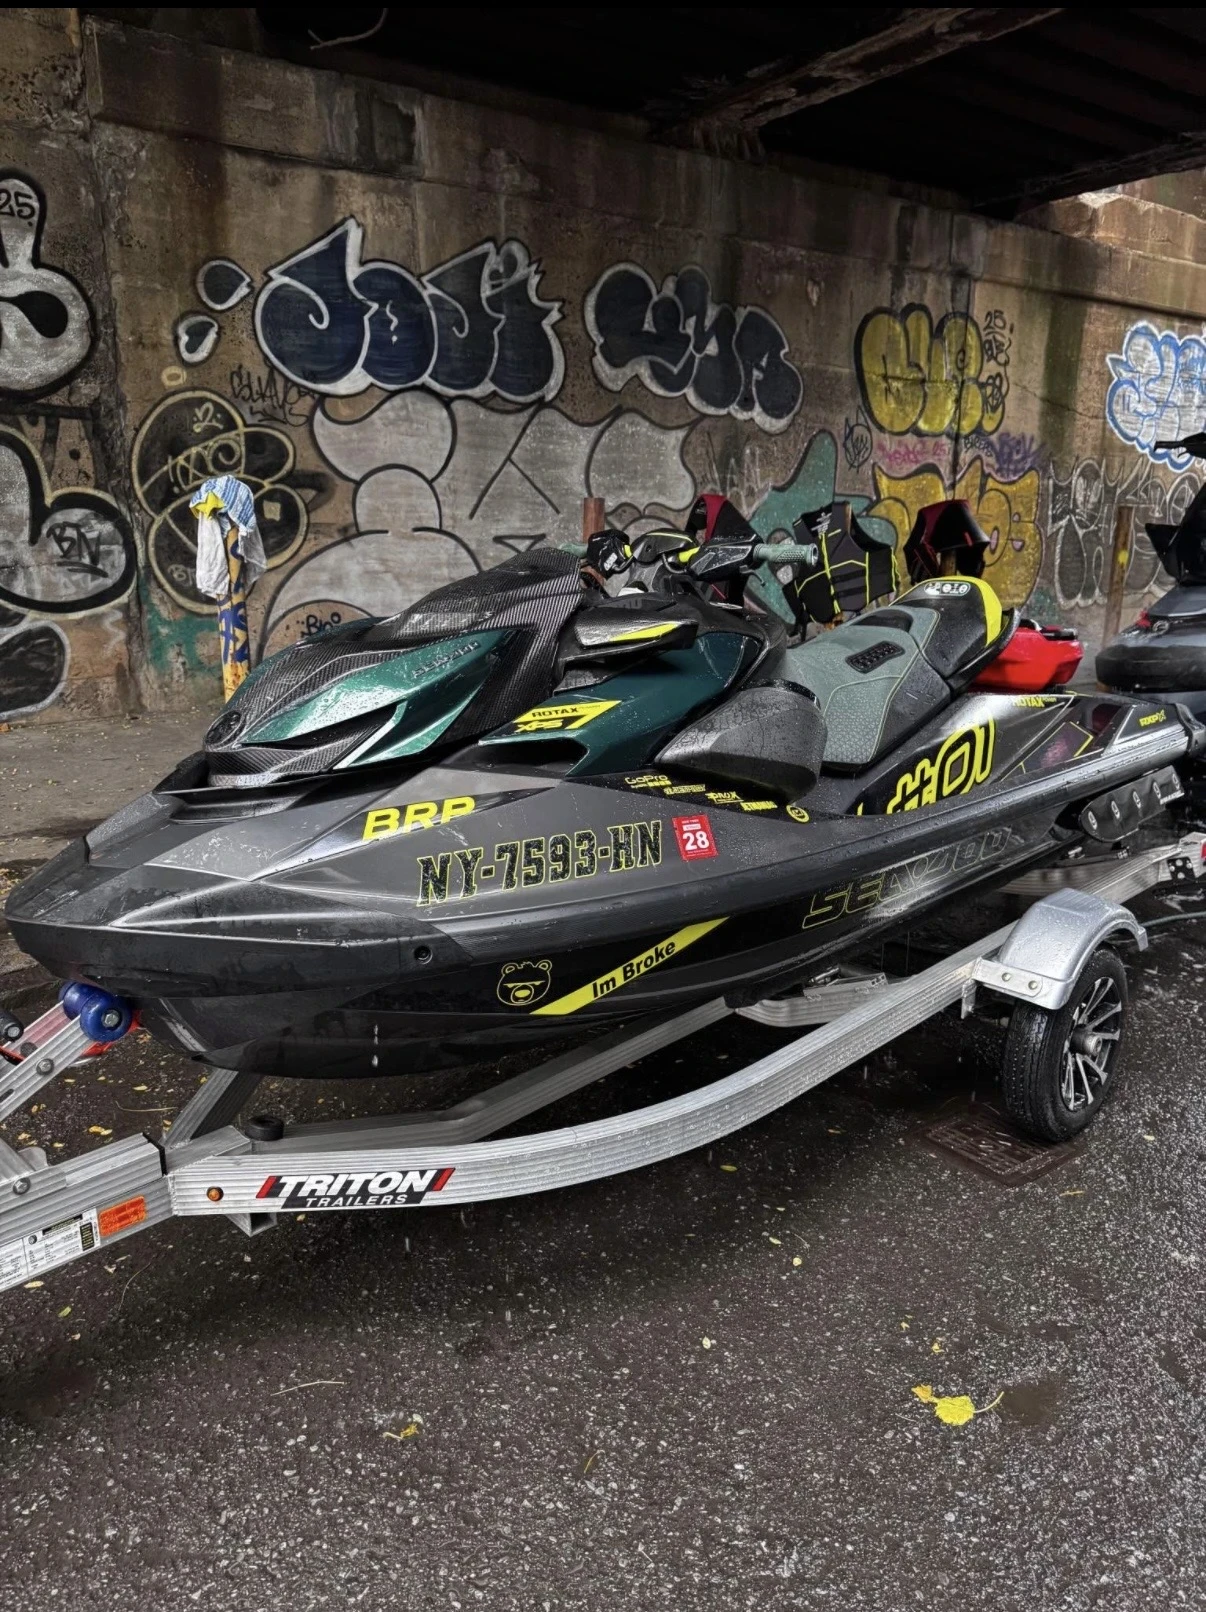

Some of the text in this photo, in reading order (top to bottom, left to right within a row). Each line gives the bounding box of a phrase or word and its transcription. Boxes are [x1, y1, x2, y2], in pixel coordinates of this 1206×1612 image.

[531, 707, 579, 718] ROTAX
[624, 774, 669, 785] GoPro
[362, 796, 476, 841] BRP
[682, 830, 710, 851] 28
[416, 820, 662, 907] NY-7593-HN
[592, 941, 676, 998] Im Broke
[278, 1169, 438, 1198] TRITON
[306, 1194, 407, 1208] TRAILERS
